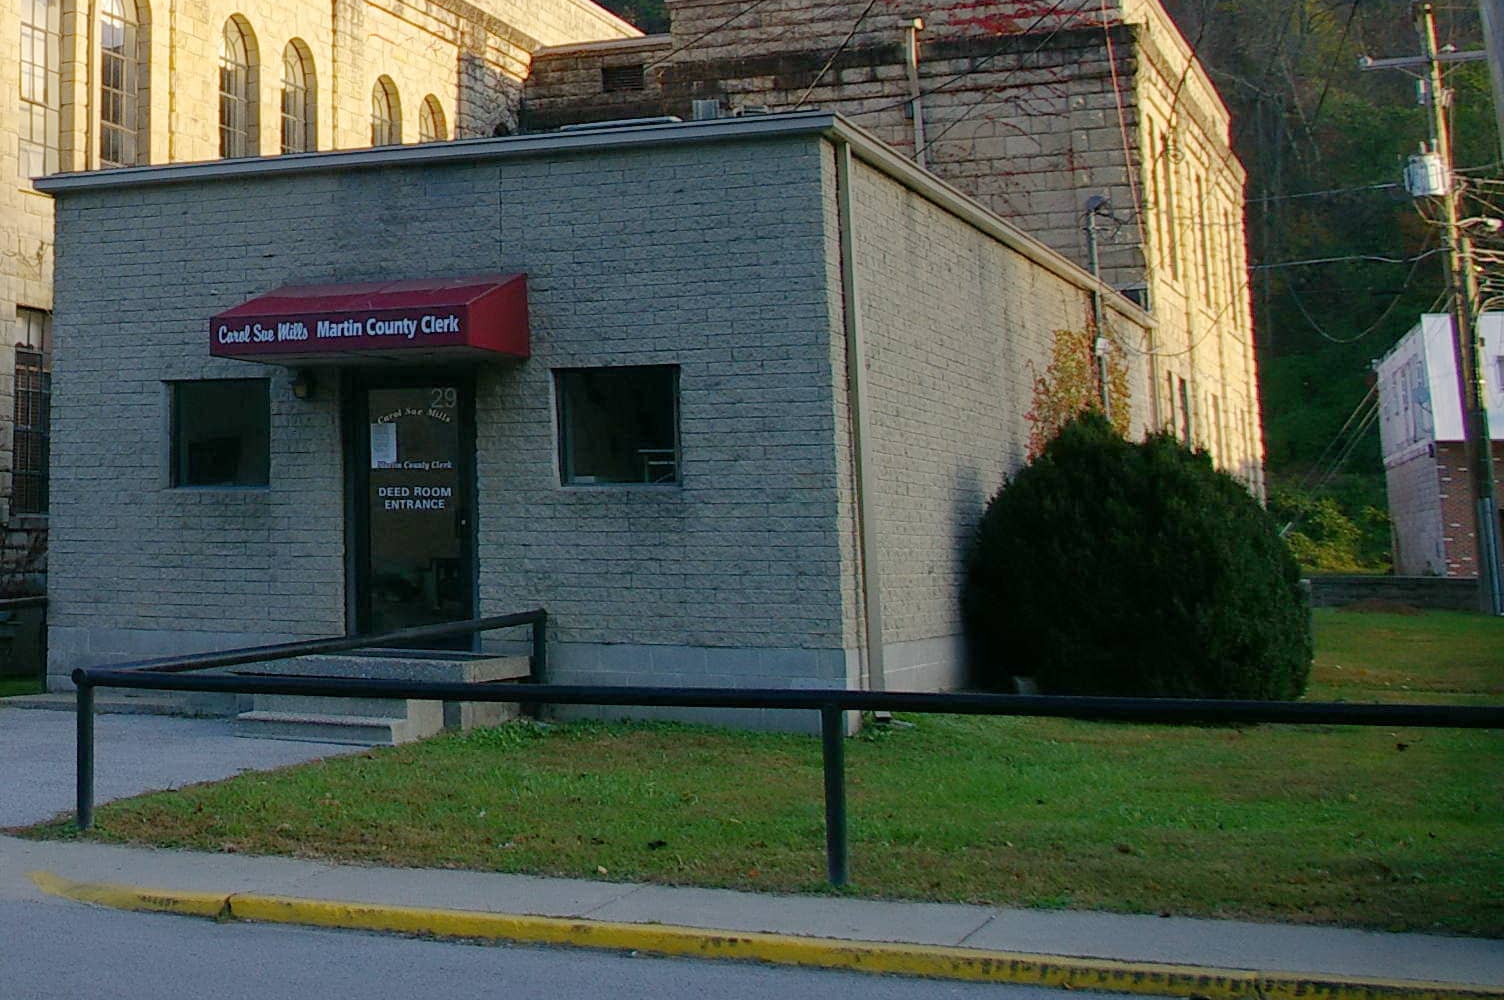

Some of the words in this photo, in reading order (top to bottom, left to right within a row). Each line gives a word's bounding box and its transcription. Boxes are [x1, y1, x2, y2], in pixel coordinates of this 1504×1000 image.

[219, 326, 250, 343] Carol
[253, 325, 274, 342] Sue
[277, 323, 308, 340] Mills
[316, 320, 362, 338] Martin
[366, 318, 417, 338] County
[421, 315, 459, 333] Clerk
[431, 387, 456, 408] 29
[377, 409, 402, 424] Carol
[405, 407, 422, 416] Sue
[427, 408, 451, 423] Mills
[403, 461, 429, 470] County
[431, 461, 452, 469] Clerk
[378, 487, 410, 497] DEED
[413, 487, 452, 497] ROOM
[384, 499, 446, 509] ENTRANCE
